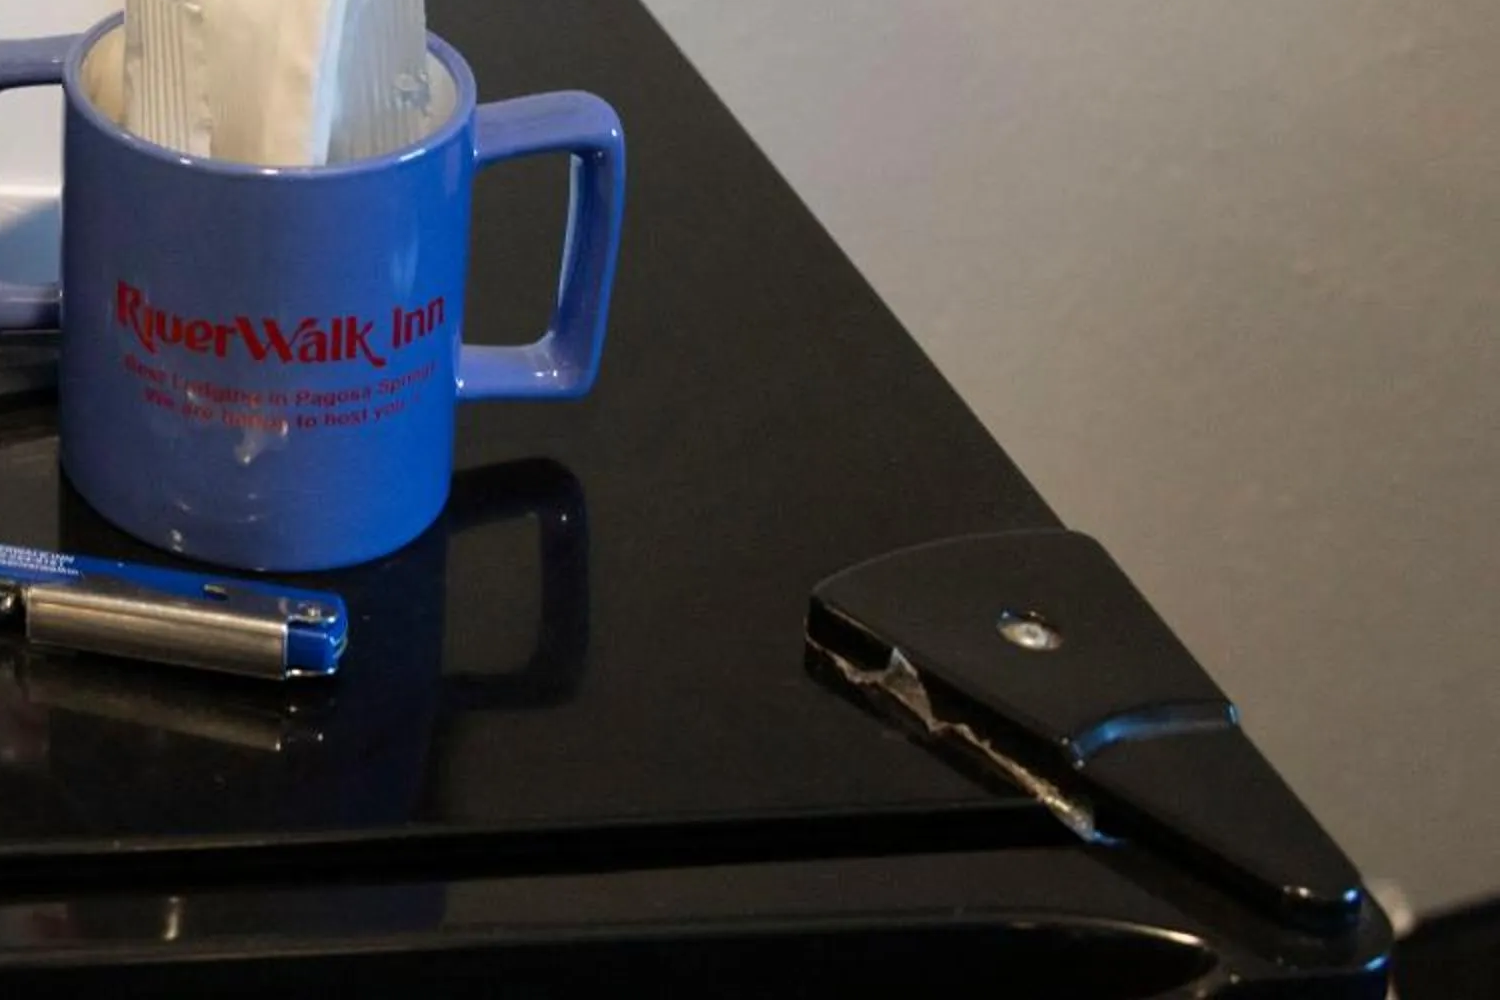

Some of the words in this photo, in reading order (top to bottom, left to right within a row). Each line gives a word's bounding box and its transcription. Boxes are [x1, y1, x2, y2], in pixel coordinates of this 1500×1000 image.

[116, 279, 387, 368] RiverWalk
[391, 295, 446, 350] Inn
[268, 390, 288, 406] in
[295, 387, 372, 408] Pagosa
[181, 400, 214, 419] are
[296, 413, 318, 429] to
[324, 407, 369, 427] host
